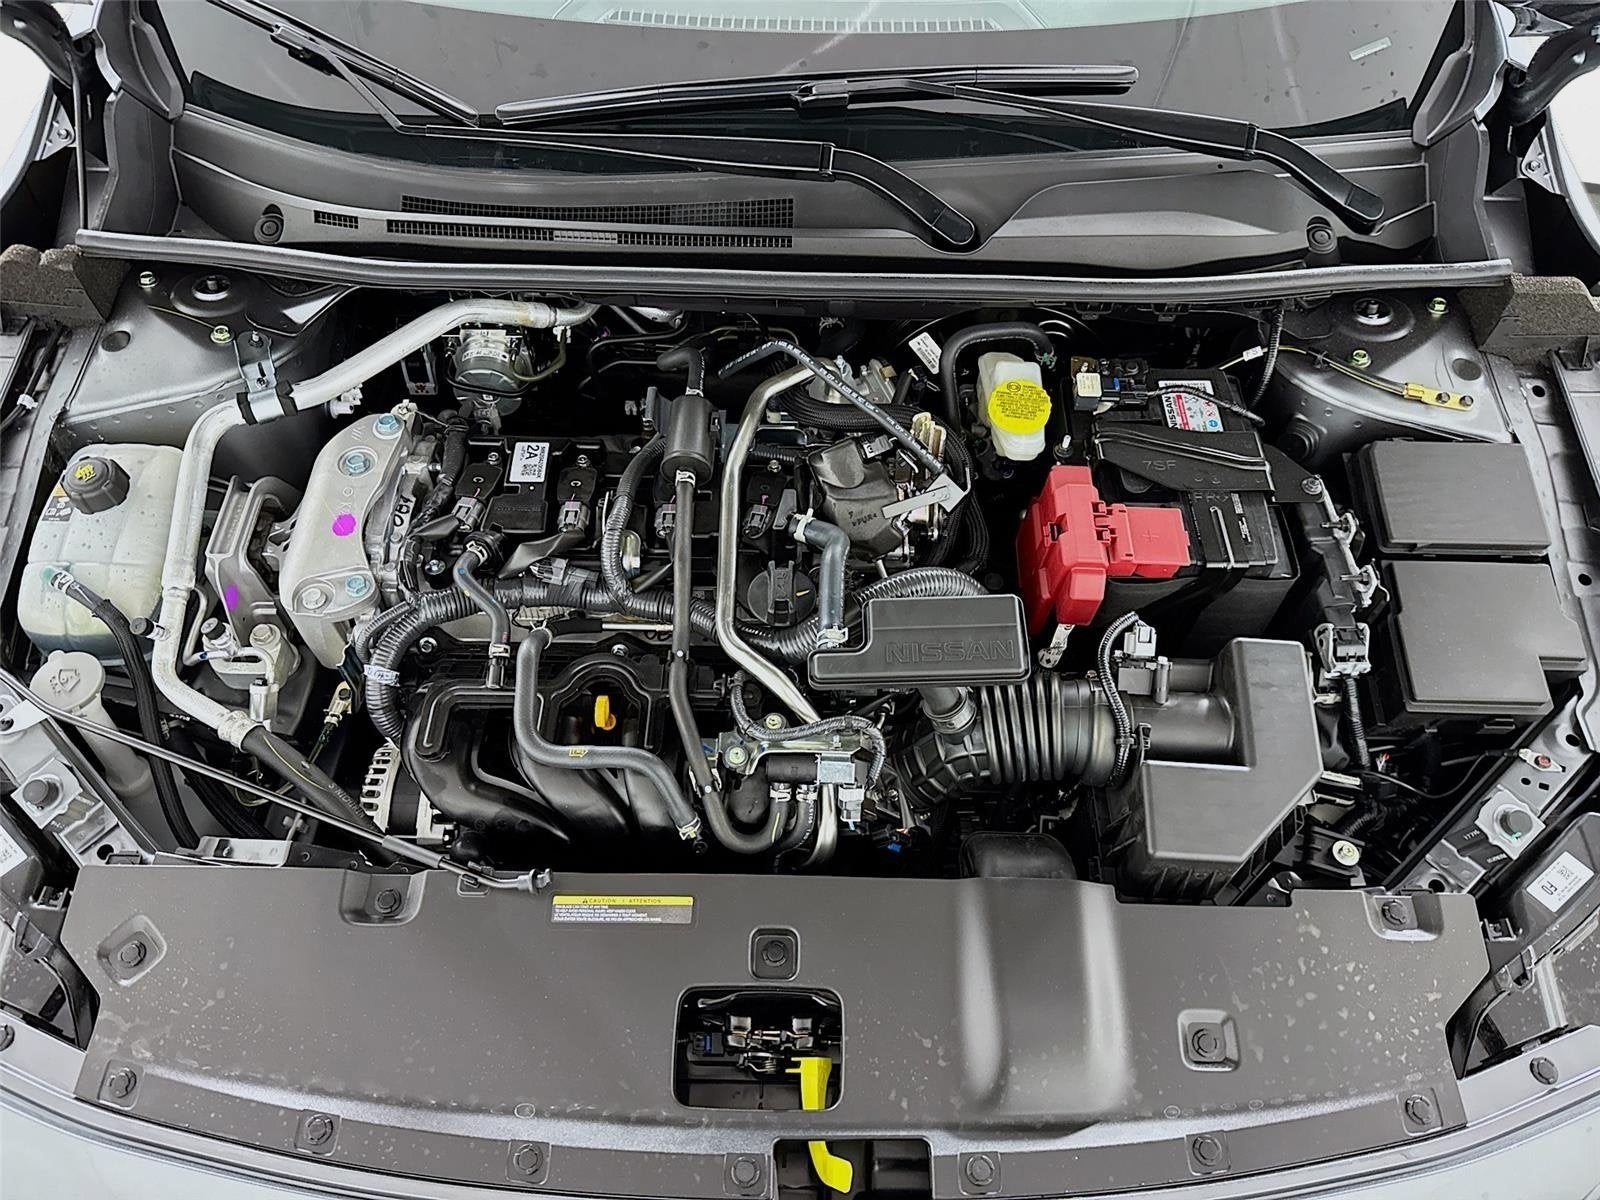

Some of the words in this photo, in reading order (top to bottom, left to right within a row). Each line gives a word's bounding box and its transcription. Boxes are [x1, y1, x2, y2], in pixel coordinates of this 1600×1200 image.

[1164, 396, 1179, 429] NISSAN
[525, 444, 540, 460] 2A
[884, 638, 1015, 664] NISSAN
